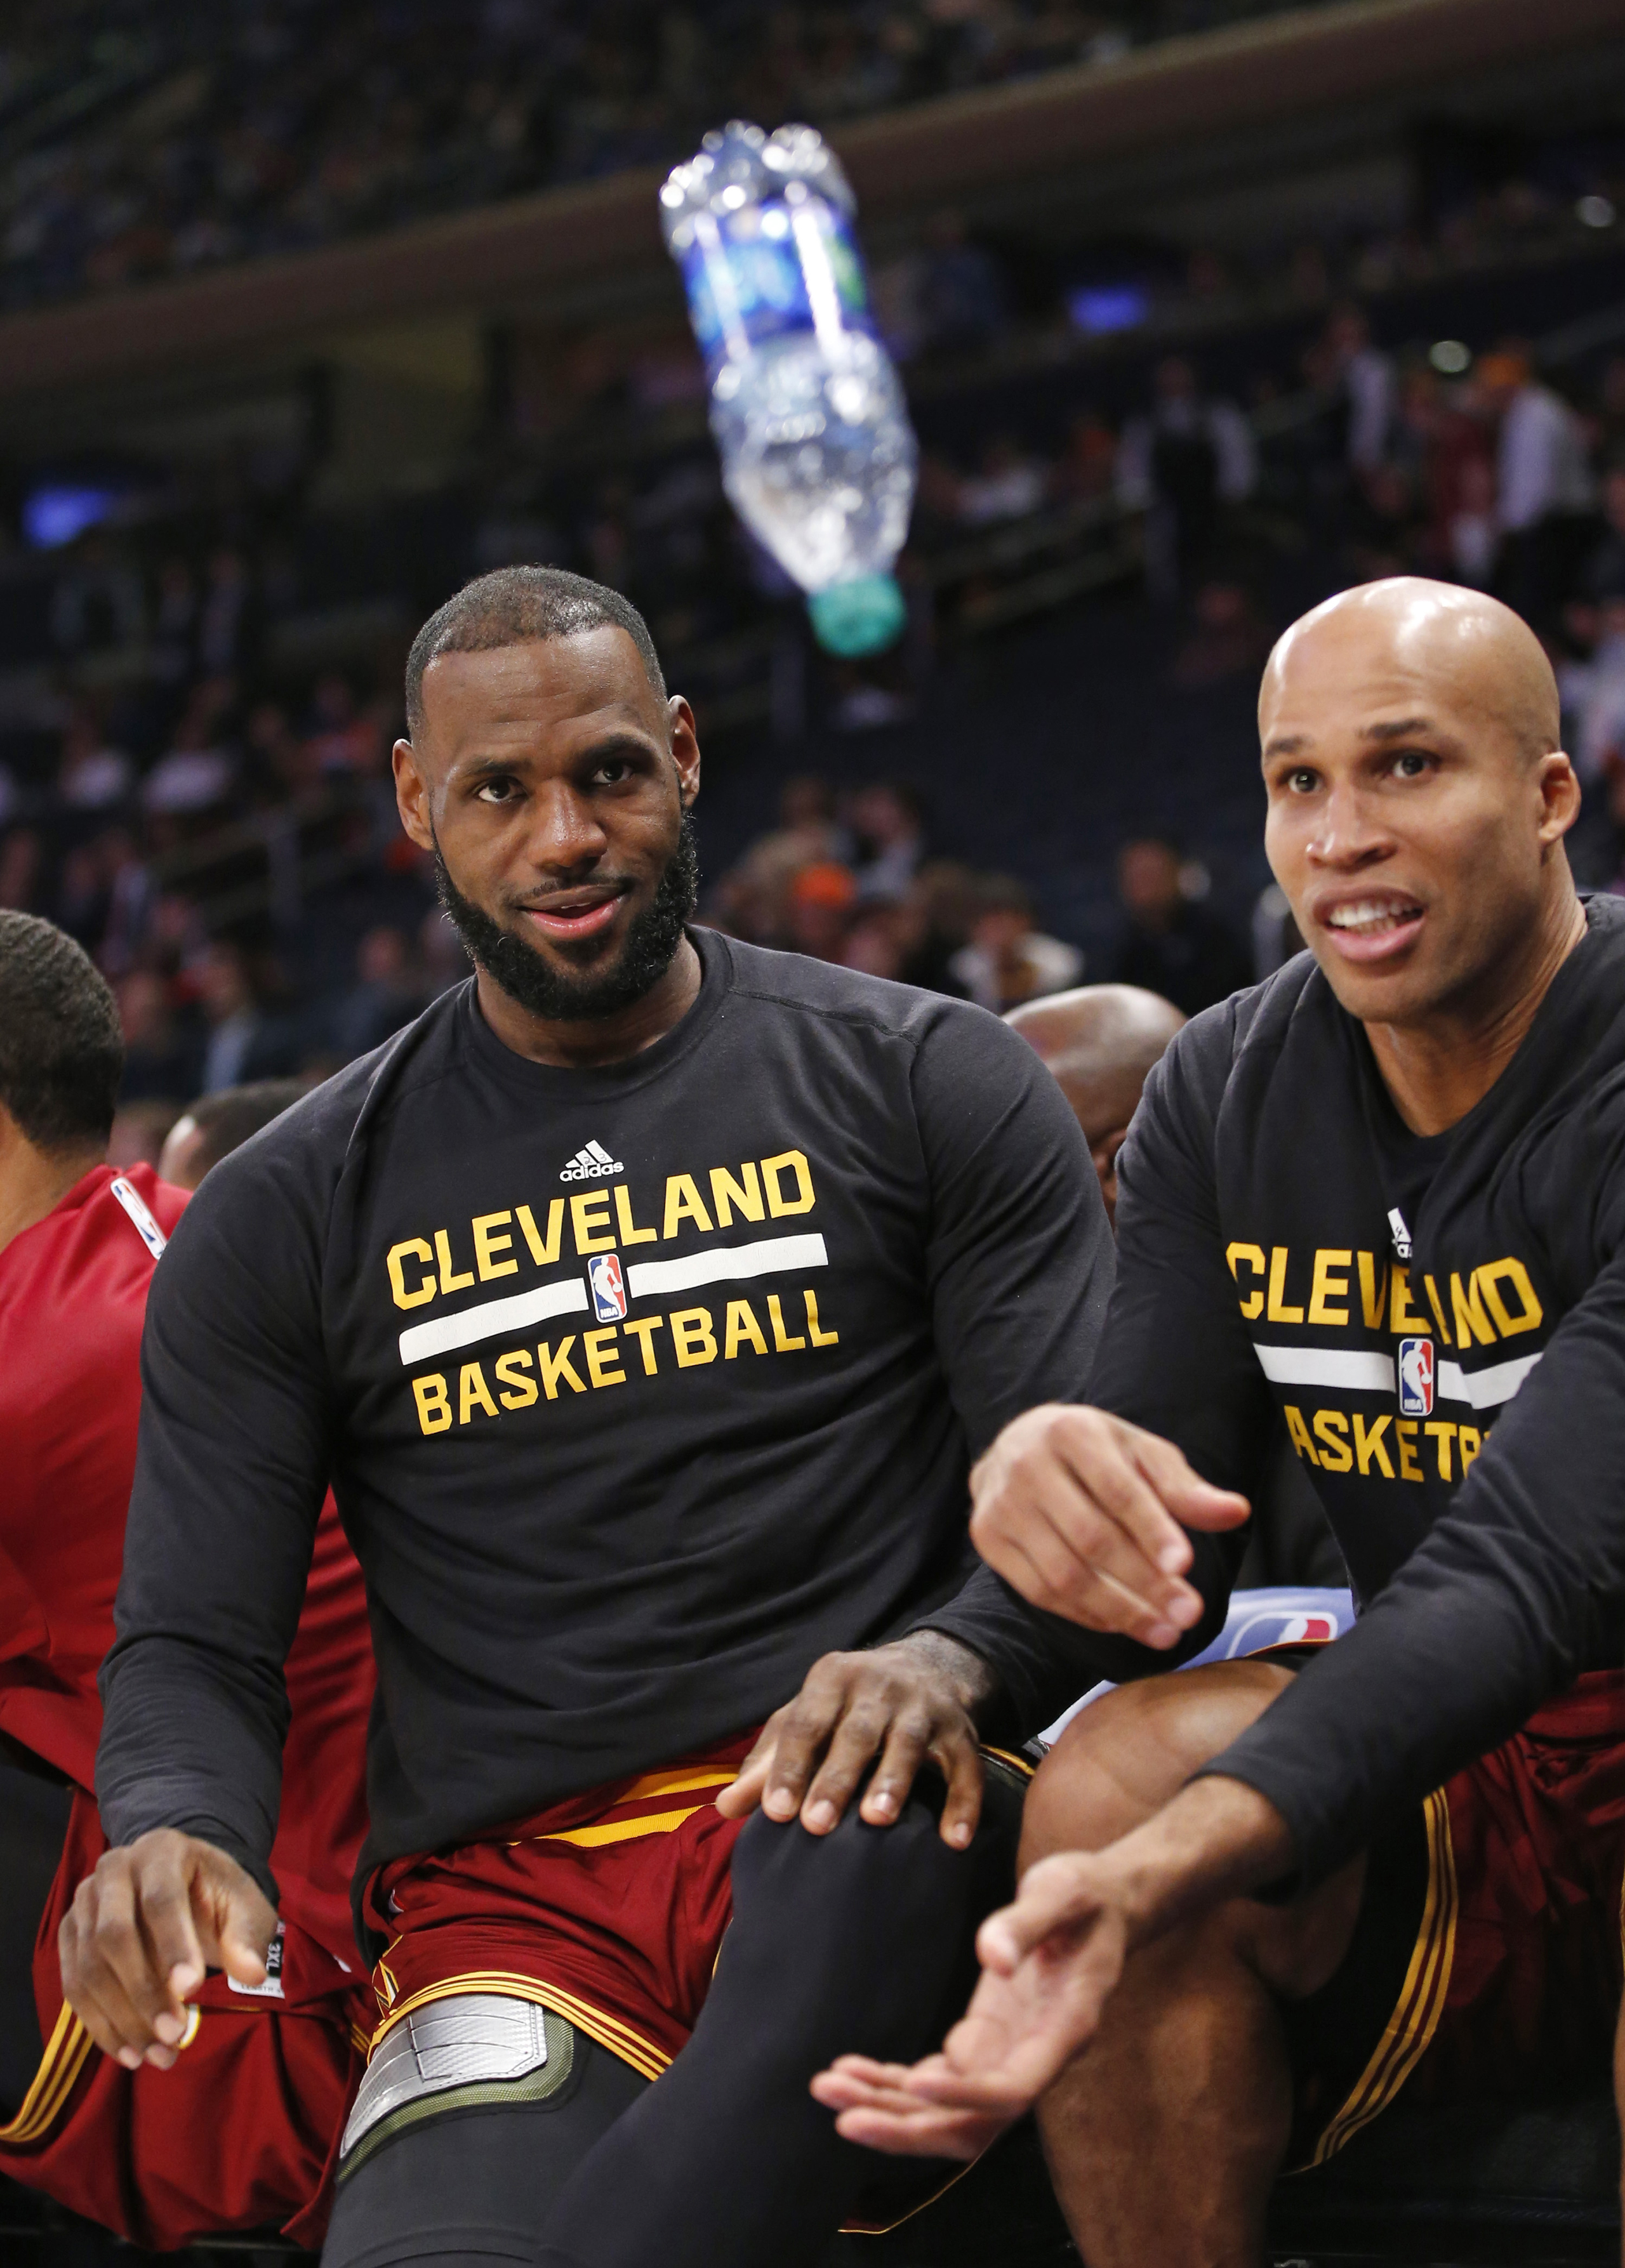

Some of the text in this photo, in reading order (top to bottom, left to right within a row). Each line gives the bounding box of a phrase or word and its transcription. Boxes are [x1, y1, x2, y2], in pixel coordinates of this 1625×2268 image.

[559, 1161, 625, 1182] adidas
[386, 1149, 817, 1311] CLEVELAND
[599, 1306, 618, 1318] NBA
[1226, 1241, 1544, 1350] CLEVEND
[411, 1289, 839, 1435] BASKETBALL
[1283, 1405, 1492, 1482] ASKETB
